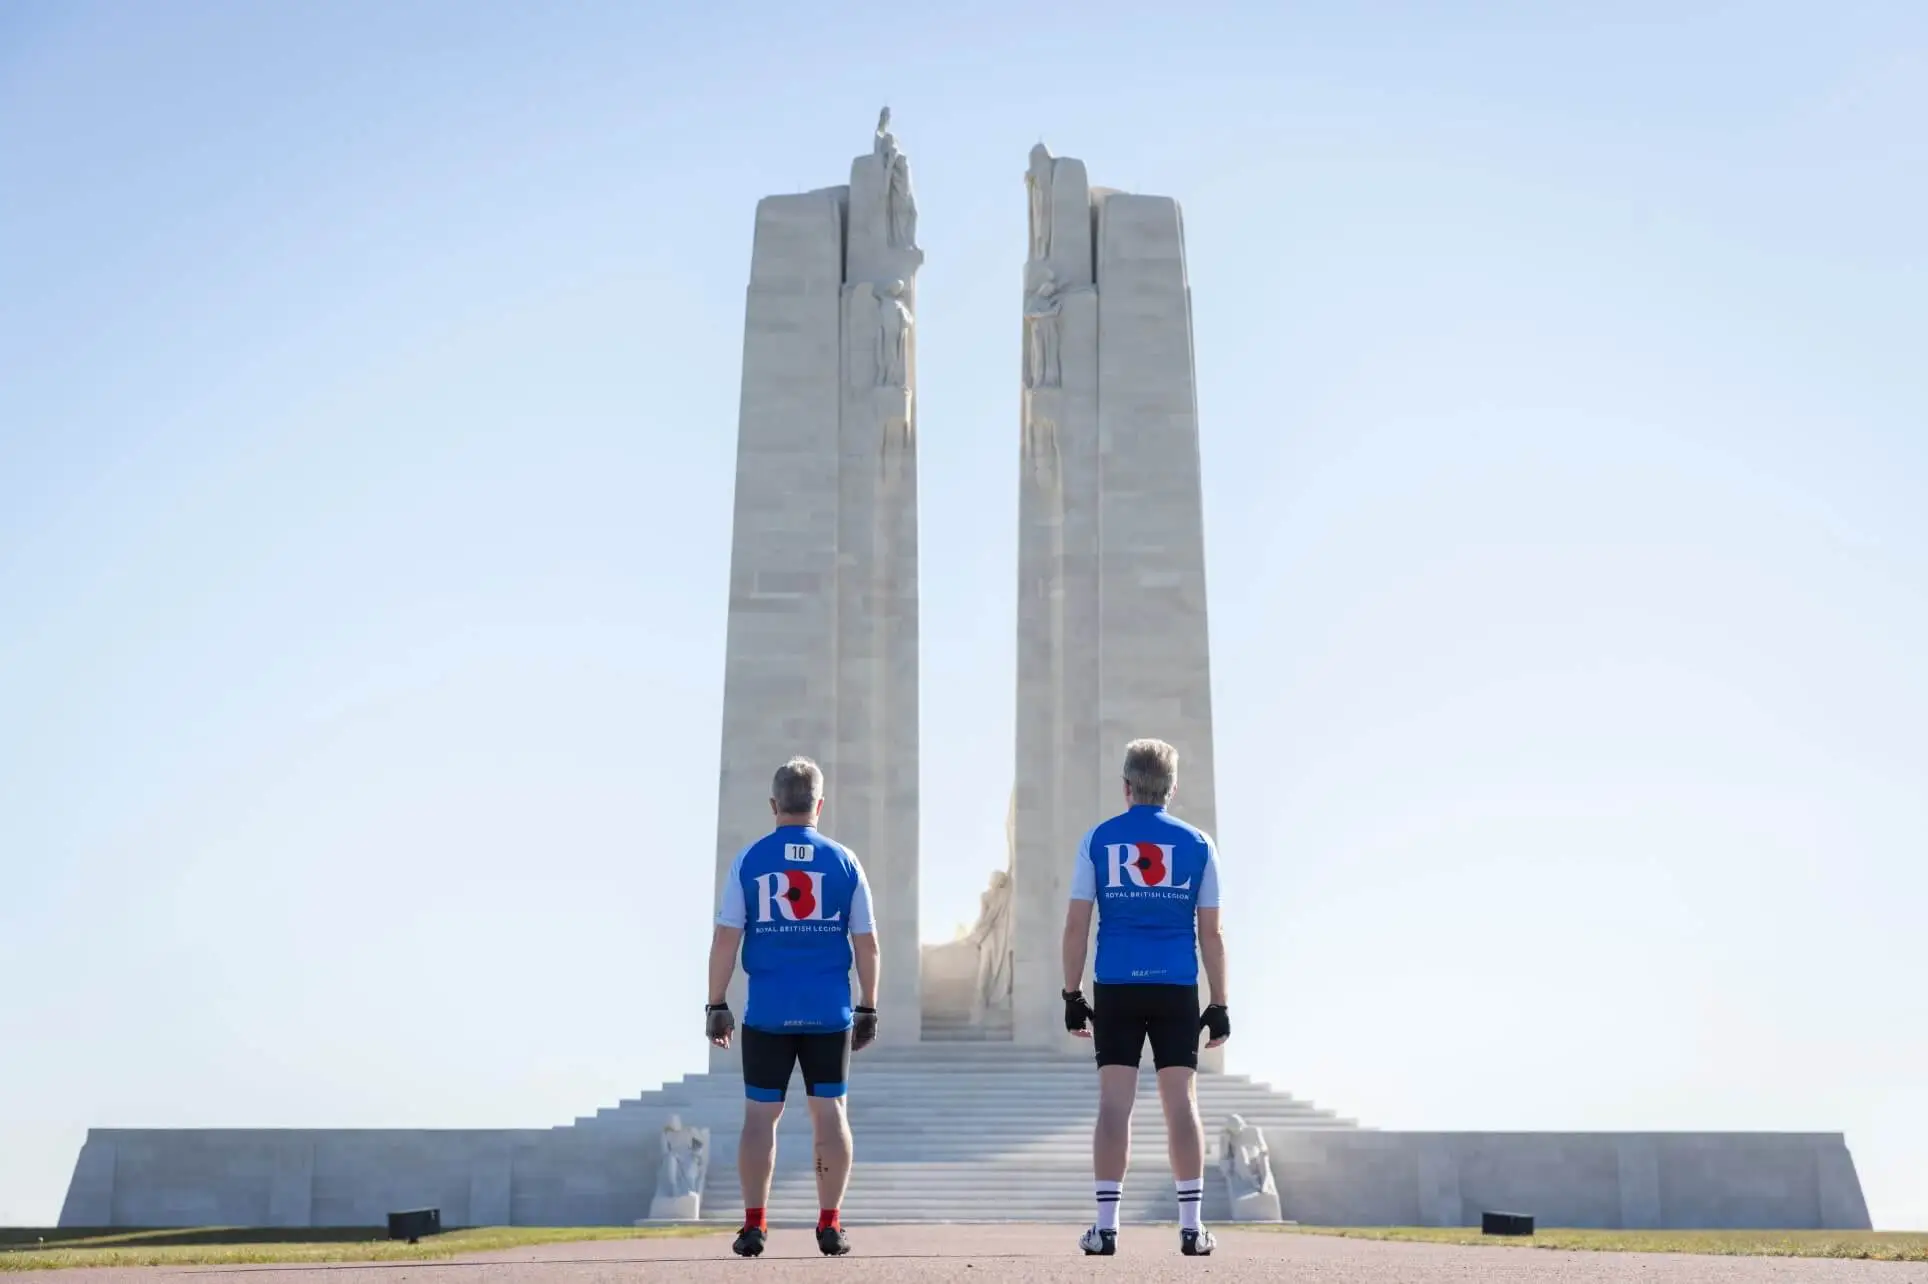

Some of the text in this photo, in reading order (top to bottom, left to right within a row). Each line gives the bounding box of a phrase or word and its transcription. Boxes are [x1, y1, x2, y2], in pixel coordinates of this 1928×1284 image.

[792, 846, 805, 859] 10
[1105, 891, 1189, 900] ROYAL BRITISH LEGION
[755, 926, 777, 934] ROYAL
[780, 925, 812, 933] BRITISH
